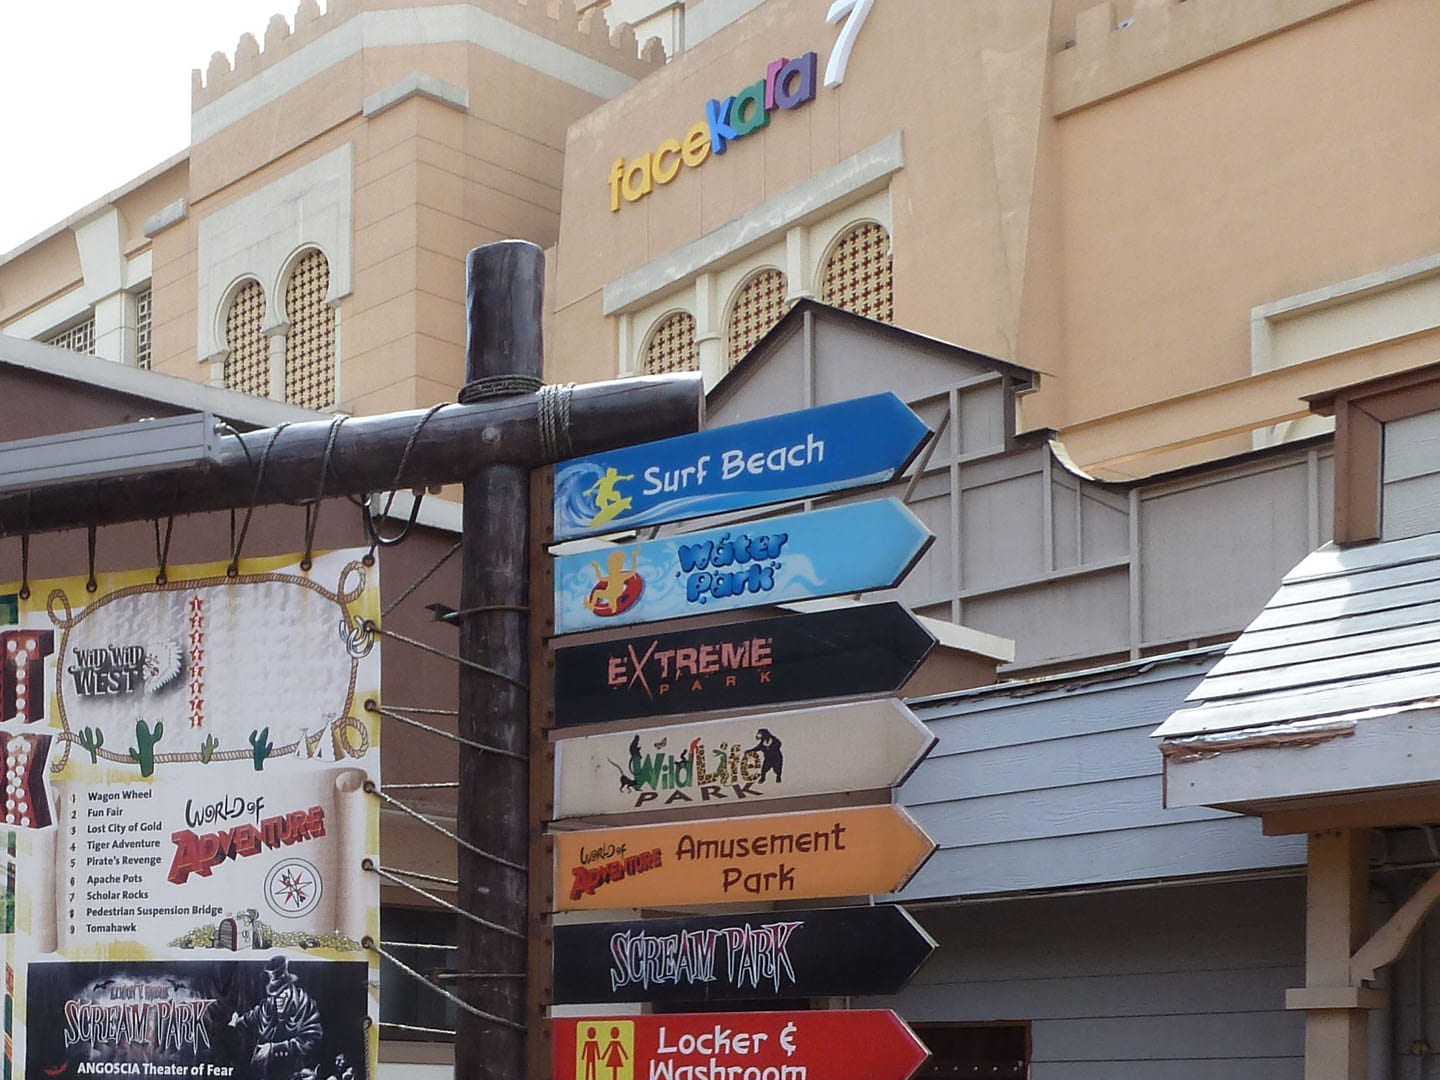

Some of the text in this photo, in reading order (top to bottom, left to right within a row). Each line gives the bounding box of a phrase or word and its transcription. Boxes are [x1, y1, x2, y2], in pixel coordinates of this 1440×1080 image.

[608, 51, 818, 213] facekara
[642, 433, 826, 497] Surf Beach
[68, 666, 138, 697] WEST
[660, 671, 773, 695] PARK
[88, 792, 120, 803] Wagon
[122, 789, 152, 799] Wheel
[634, 782, 764, 807] PARK
[87, 808, 104, 817] Fun
[106, 807, 123, 816] Fair
[185, 793, 245, 828] WORLD
[87, 824, 106, 834] Lost
[108, 823, 126, 835] City
[128, 822, 138, 832] of
[140, 821, 162, 831] Gold
[87, 840, 110, 852] Tiger
[112, 839, 161, 848] Adventure
[167, 804, 326, 885] ADVENTURE
[676, 823, 846, 860] Amusement
[122, 855, 162, 866] Revenge
[87, 874, 120, 886] Apache
[123, 874, 143, 883] Pots
[723, 864, 795, 895] Park
[86, 891, 120, 900] Scholar
[122, 890, 149, 899] Rocks
[86, 907, 135, 917] Pedestrian
[137, 906, 190, 917] Suspension
[192, 905, 223, 917] Bridge
[86, 923, 137, 933] Tomahawk
[610, 921, 805, 994] SCREAM PARK
[64, 999, 217, 1056] SCREAM PARK
[657, 1021, 798, 1057] Locker &
[77, 1062, 234, 1077] ANGOSCIA Theater of Fear
